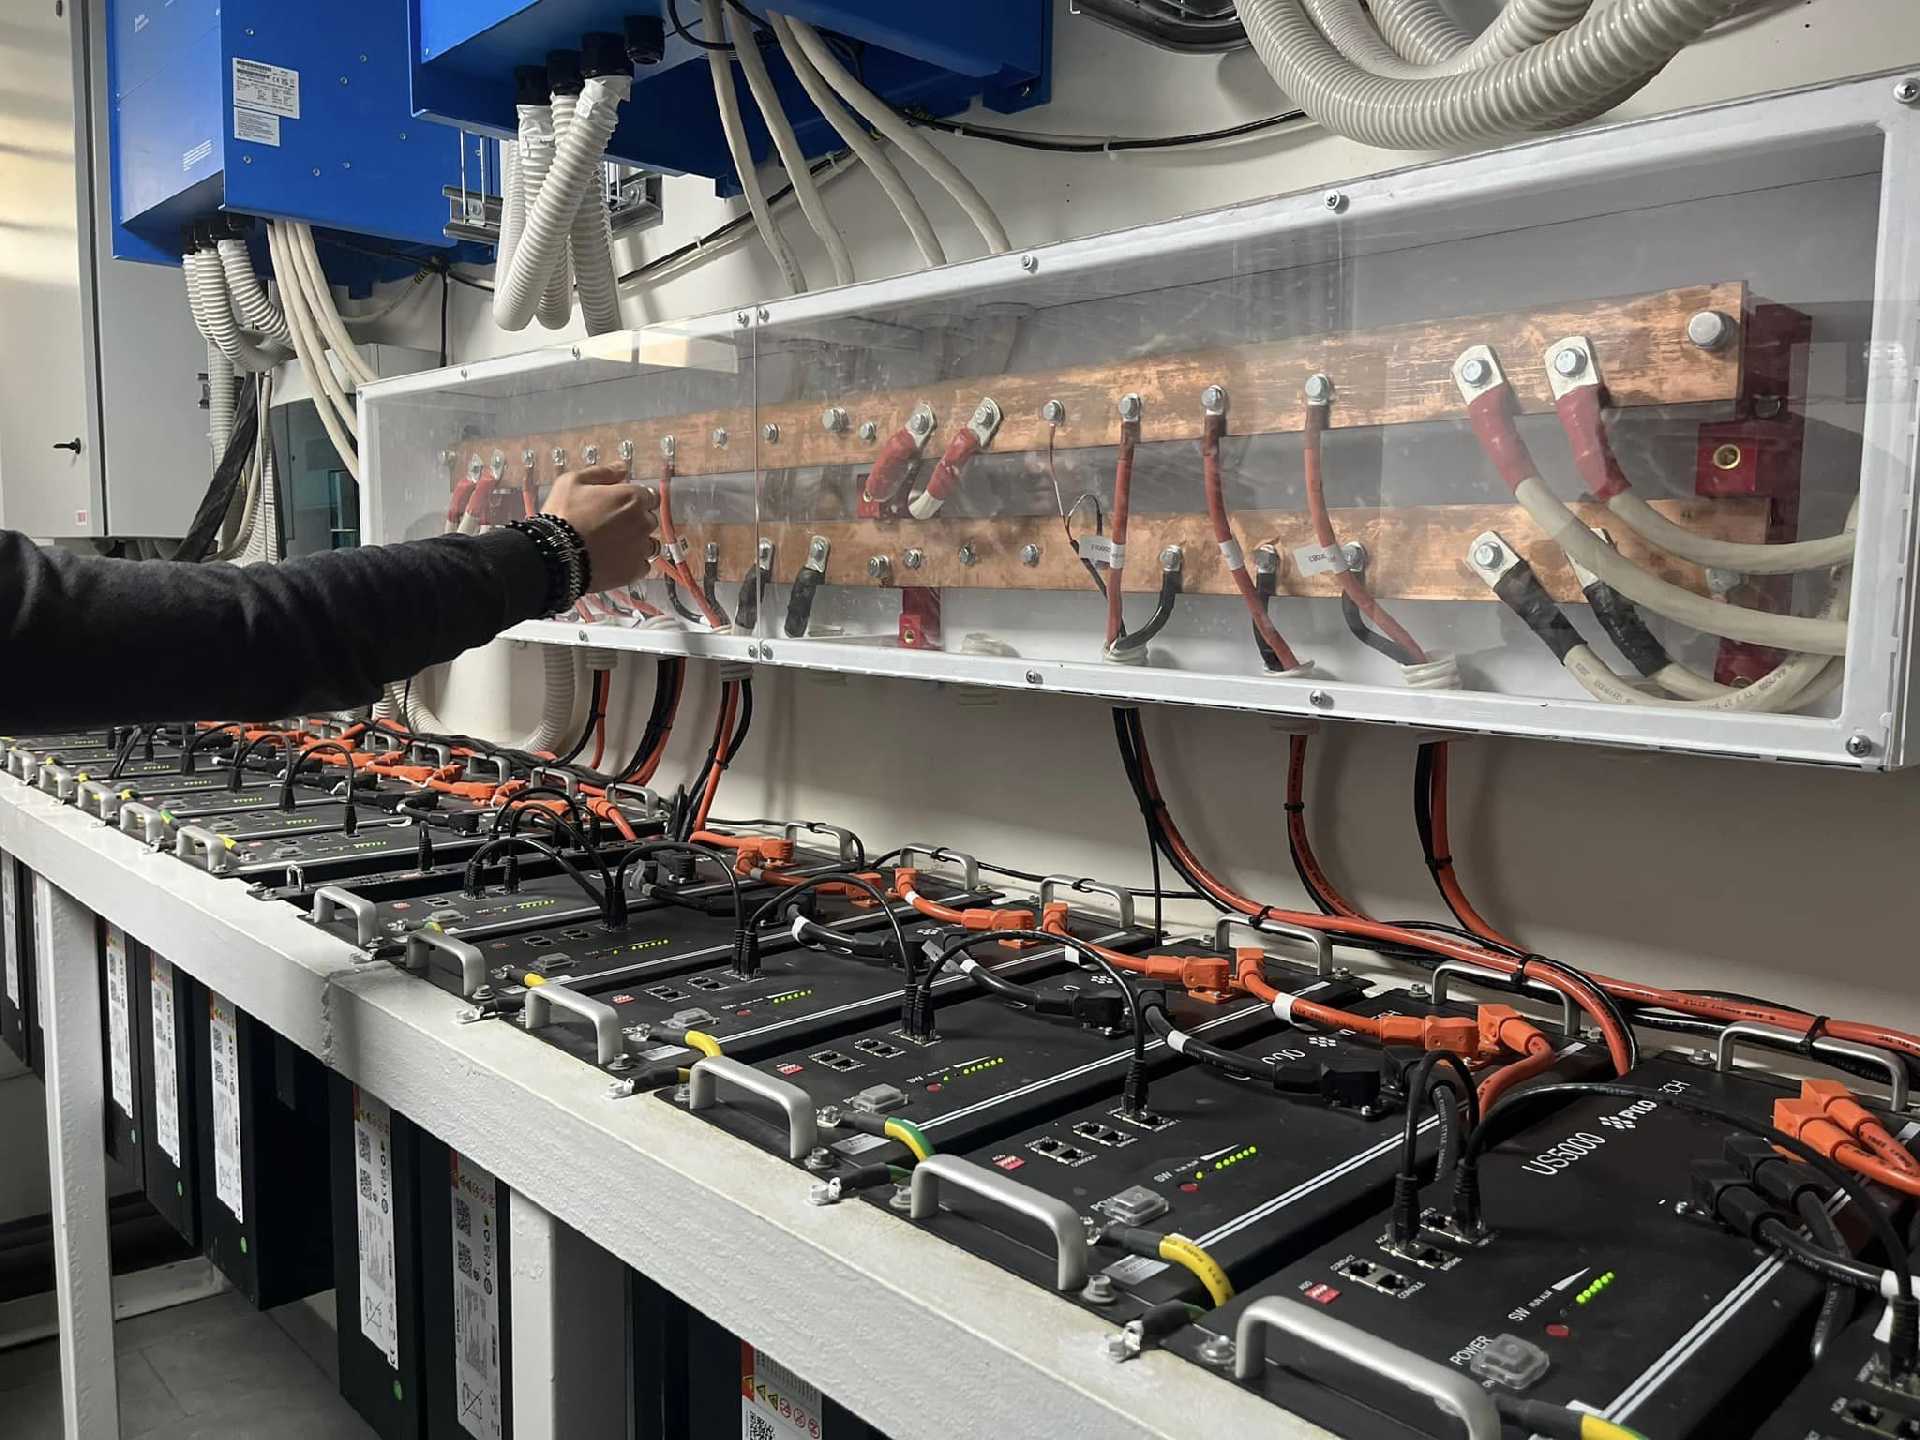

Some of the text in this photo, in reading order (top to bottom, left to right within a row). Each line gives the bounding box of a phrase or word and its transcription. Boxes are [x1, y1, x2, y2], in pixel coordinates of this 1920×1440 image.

[1521, 1079, 1691, 1176] US5000 PYLOCH
[1507, 1306, 1531, 1322] SW
[1449, 1335, 1495, 1366] POWER
